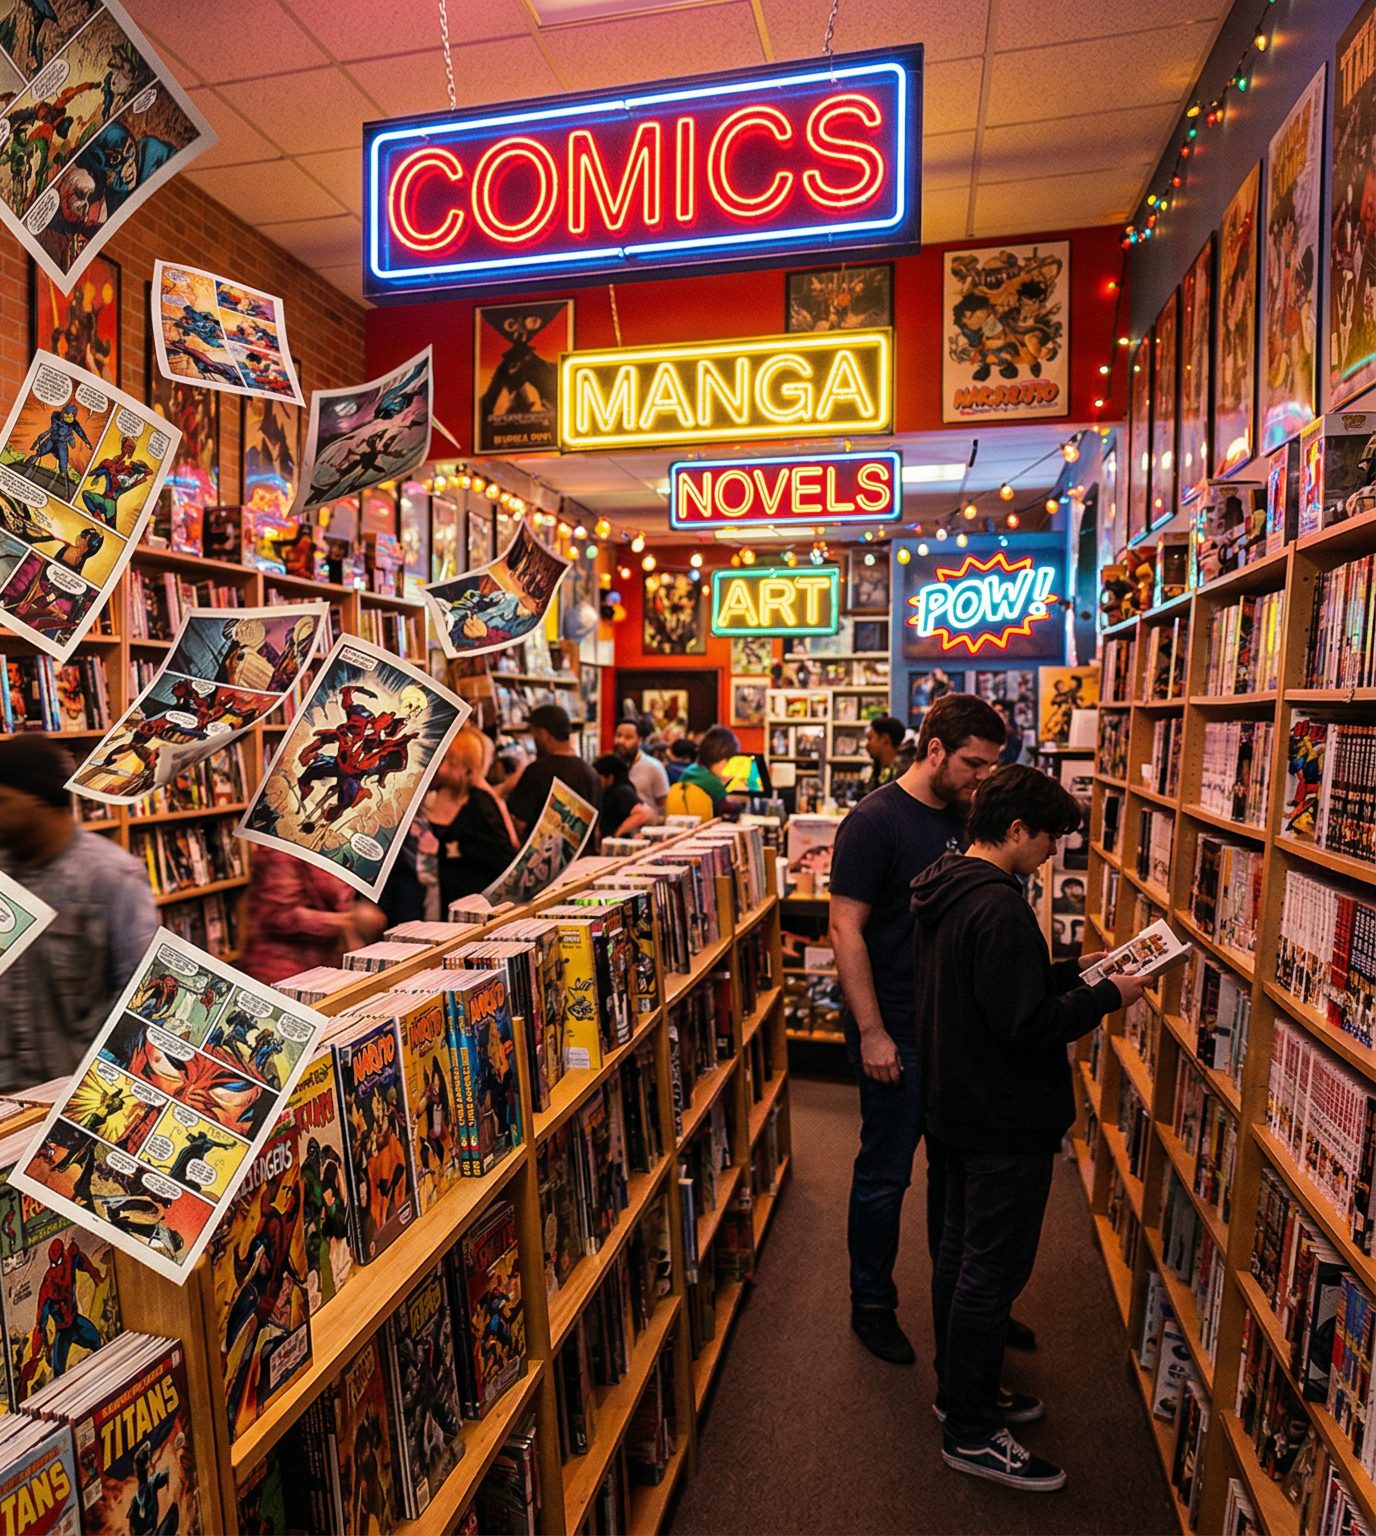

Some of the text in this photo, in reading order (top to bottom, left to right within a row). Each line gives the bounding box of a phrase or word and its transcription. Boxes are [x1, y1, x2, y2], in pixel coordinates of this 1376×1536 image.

[387, 93, 886, 252] COMICS
[575, 350, 874, 433] MANGA
[677, 462, 891, 518] NOVELS
[717, 576, 831, 628] ART
[916, 566, 1055, 637] POW!
[100, 1374, 180, 1472] TITANS
